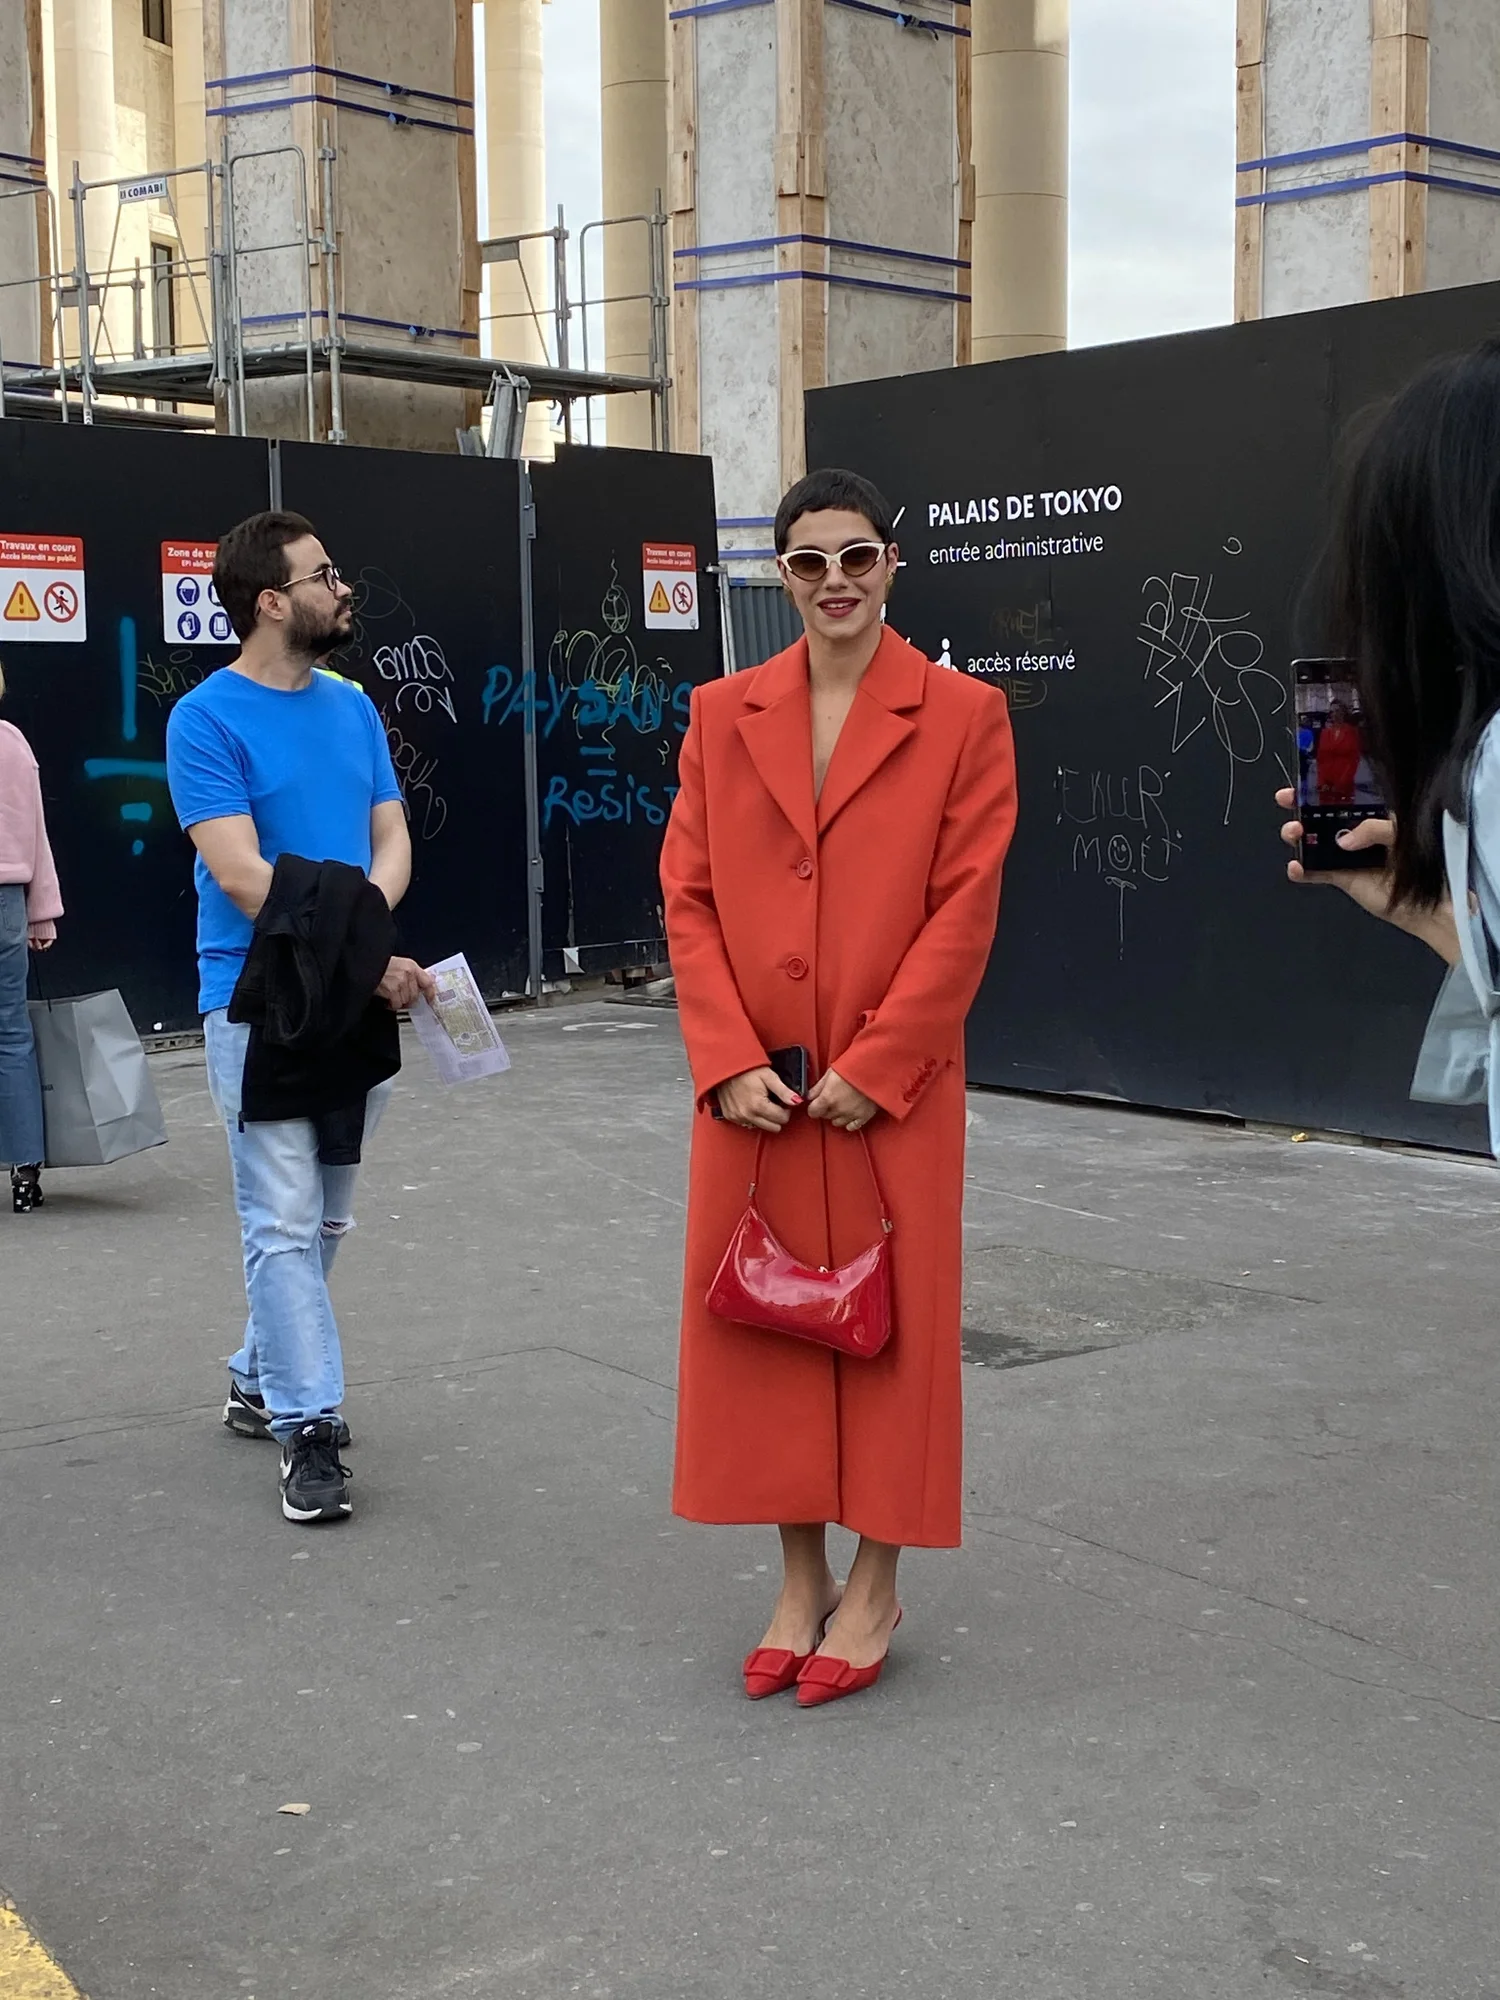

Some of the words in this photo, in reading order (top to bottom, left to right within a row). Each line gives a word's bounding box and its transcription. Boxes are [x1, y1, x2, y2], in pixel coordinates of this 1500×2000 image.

[128, 183, 163, 197] COMABI
[928, 497, 1000, 527] PALAIS
[1006, 494, 1035, 520] DE
[1040, 485, 1122, 516] TOKYO
[0, 540, 36, 551] Travaux
[38, 543, 50, 552] en
[51, 544, 76, 553] cours
[167, 546, 190, 558] Zone
[191, 547, 204, 558] de
[929, 541, 980, 564] entrée
[985, 532, 1104, 560] administrative
[967, 651, 1011, 673] accès
[1015, 648, 1076, 672] réservé
